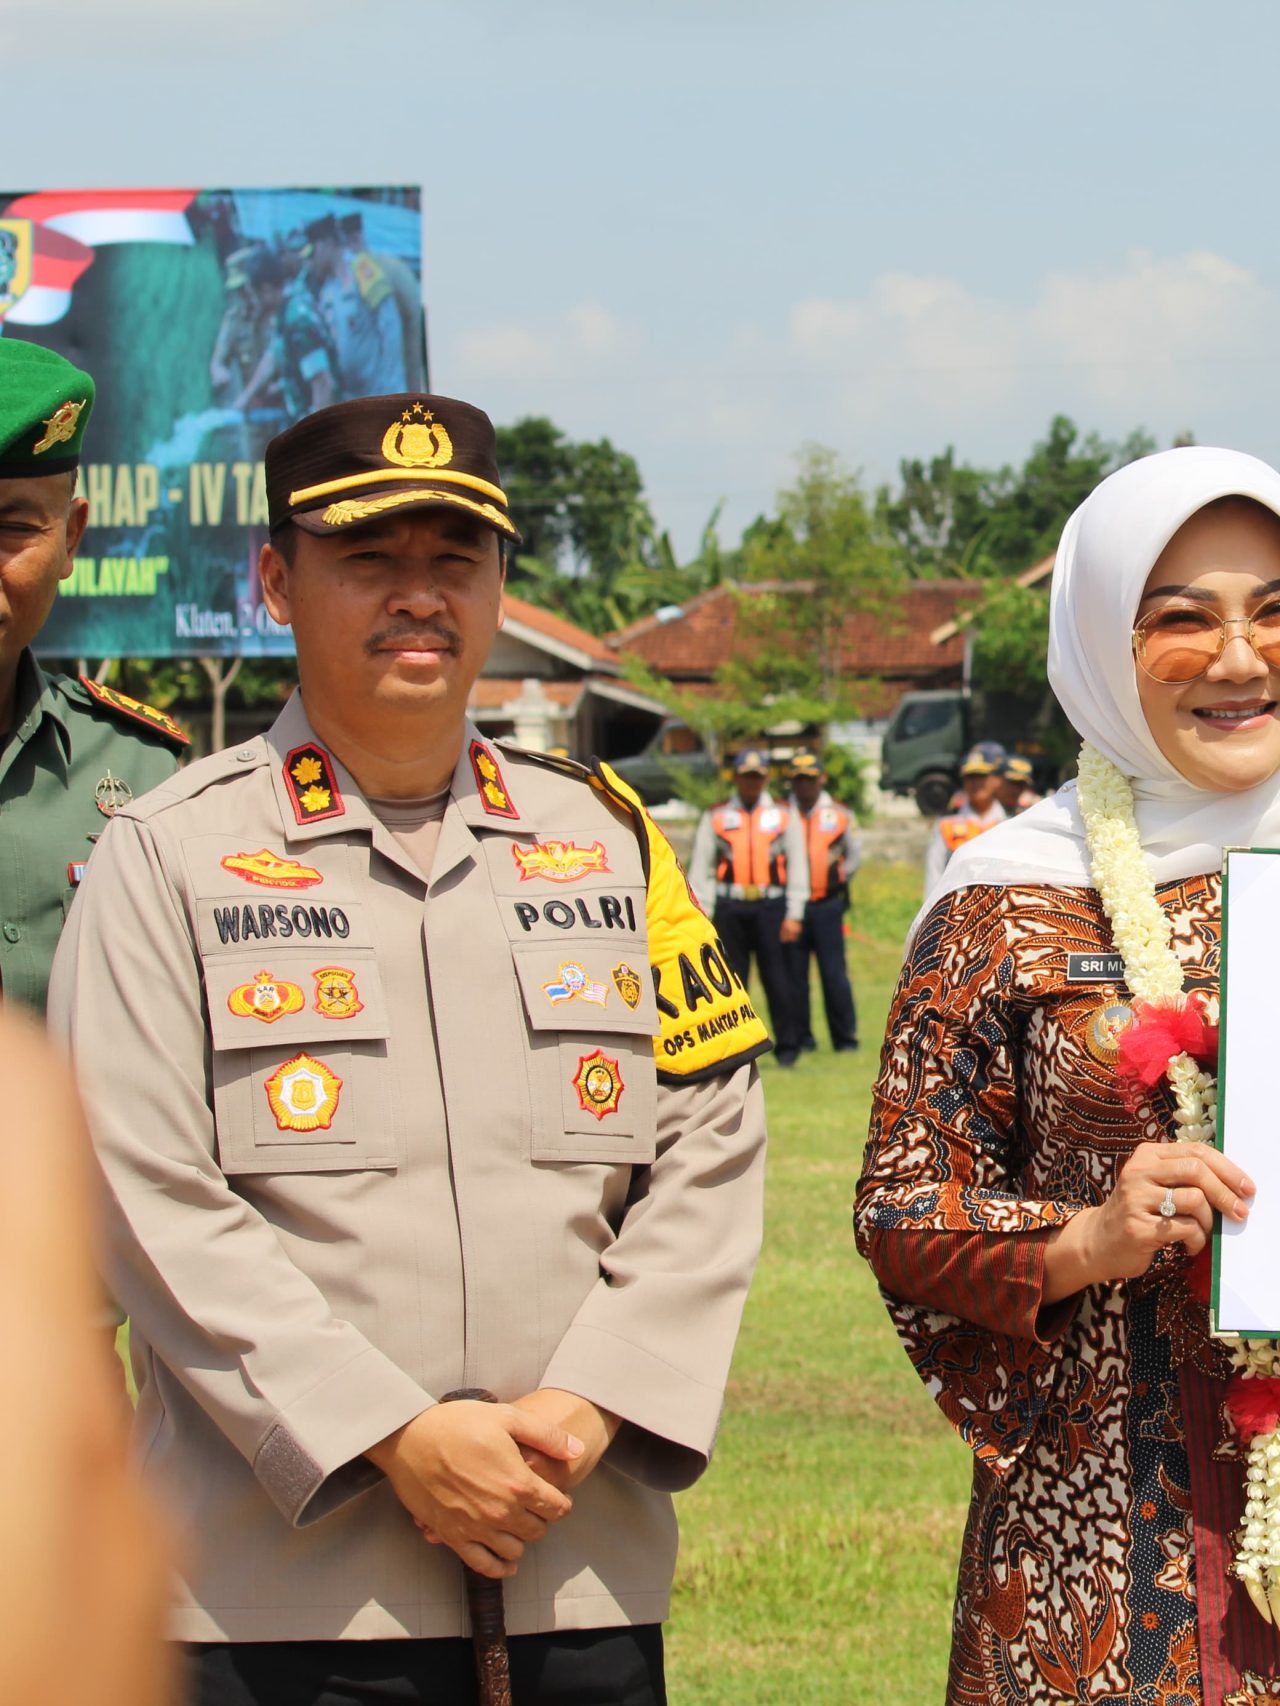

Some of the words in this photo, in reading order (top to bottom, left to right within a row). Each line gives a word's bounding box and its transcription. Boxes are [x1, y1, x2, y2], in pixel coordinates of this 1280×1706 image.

[189, 463, 227, 526] IV
[213, 904, 350, 944] WARSONO
[513, 895, 636, 932] POLRI
[651, 937, 741, 1019] KAO
[1080, 960, 1103, 972] SRI
[663, 1030, 695, 1056] OPS
[697, 1010, 739, 1043] MANTAP
